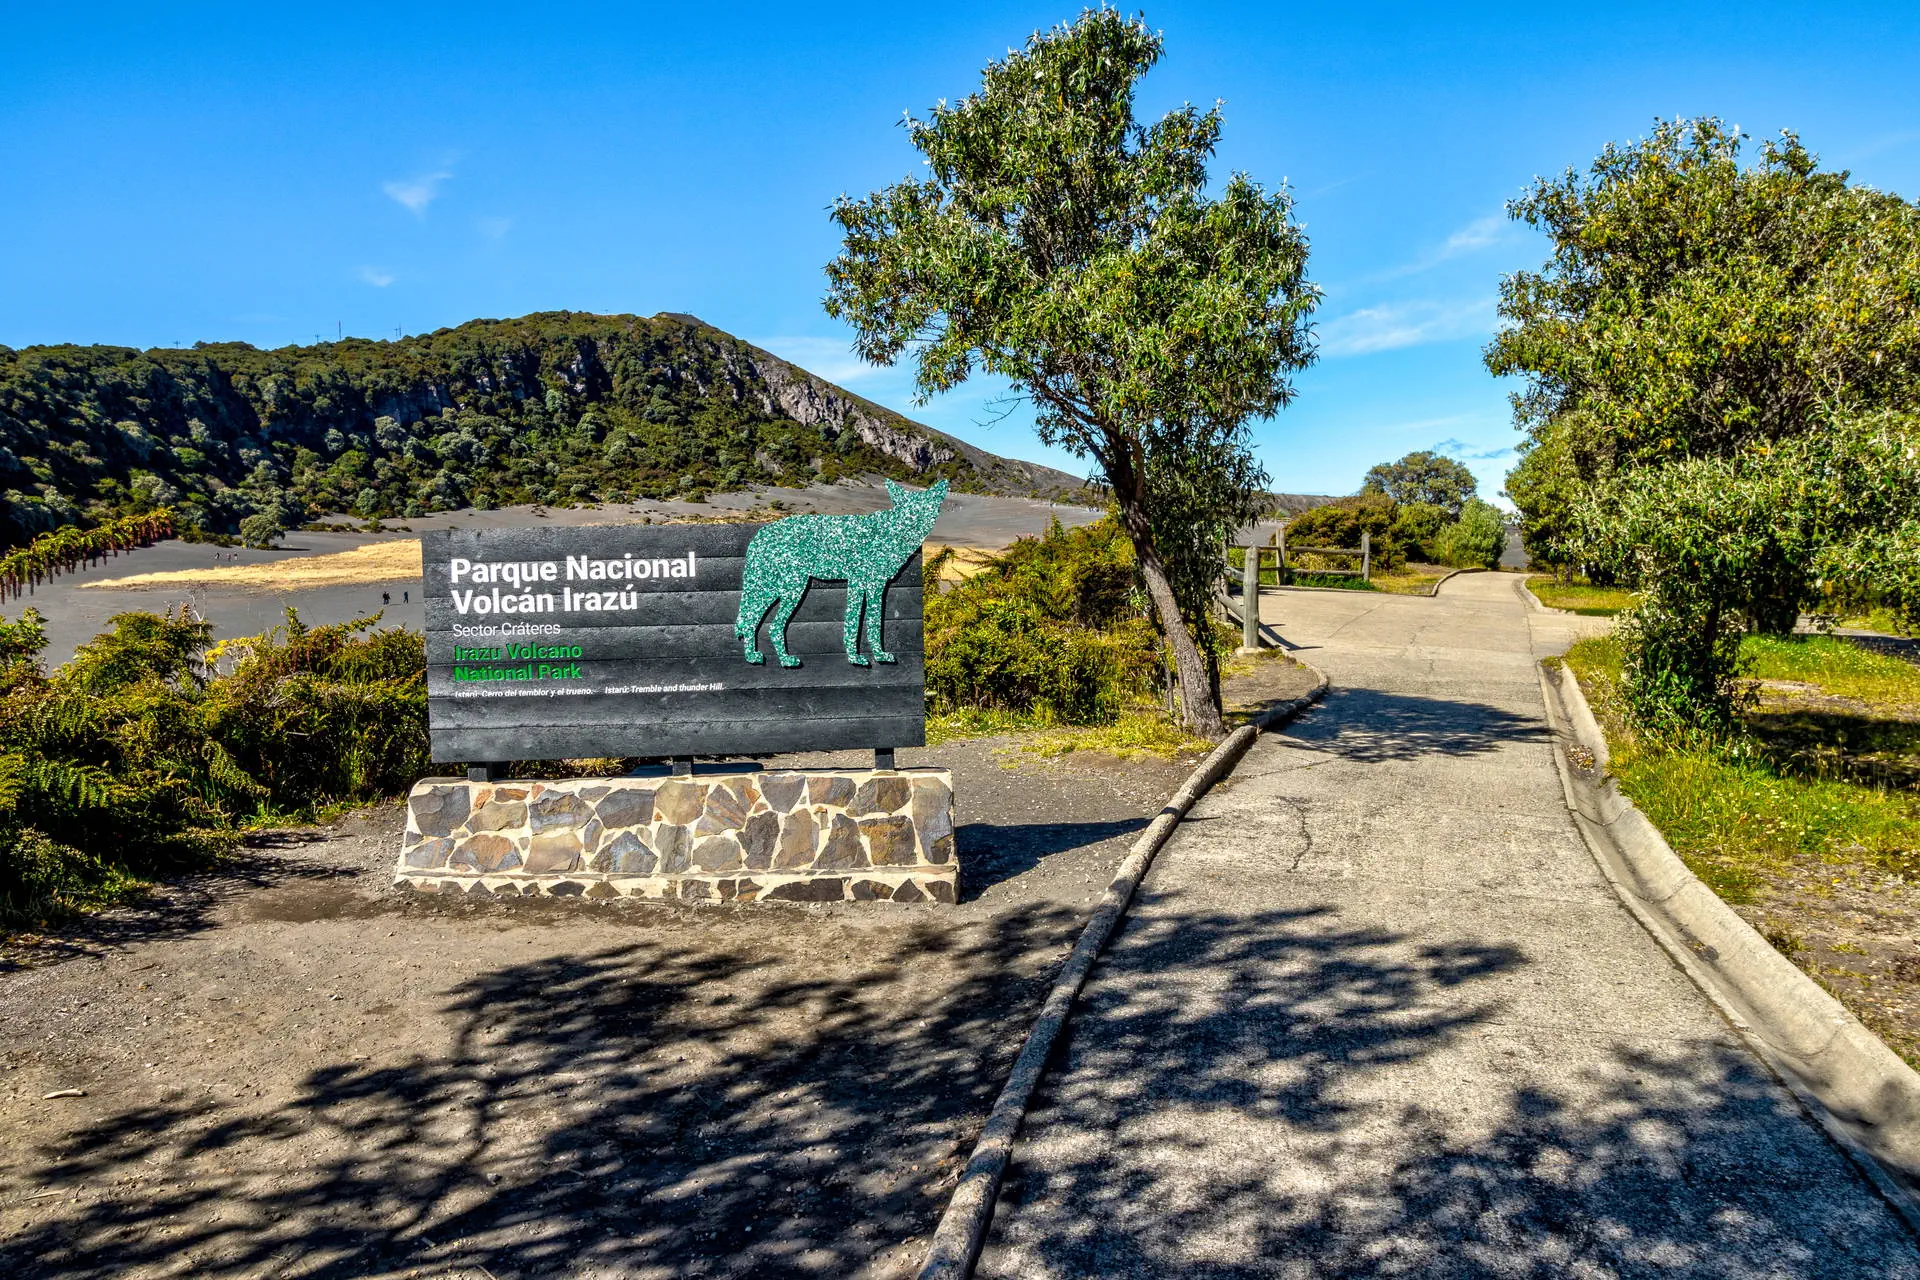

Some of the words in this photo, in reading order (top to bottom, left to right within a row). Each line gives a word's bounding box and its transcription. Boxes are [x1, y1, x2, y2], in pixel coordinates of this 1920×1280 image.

[450, 558, 558, 588] Parque
[566, 552, 696, 581] Nacional
[451, 587, 555, 615] Volcán
[563, 584, 638, 612] Irazú
[452, 624, 498, 637] Sector
[501, 622, 561, 636] Cráteres
[455, 645, 501, 661] Irazu
[506, 642, 583, 659] Volcano
[454, 664, 533, 682] National
[538, 663, 582, 680] Park
[505, 689, 517, 697] del
[519, 688, 549, 697] temblor
[550, 689, 556, 697] y
[631, 685, 662, 693] Tremble
[663, 684, 678, 692] and
[679, 683, 709, 691] thunder
